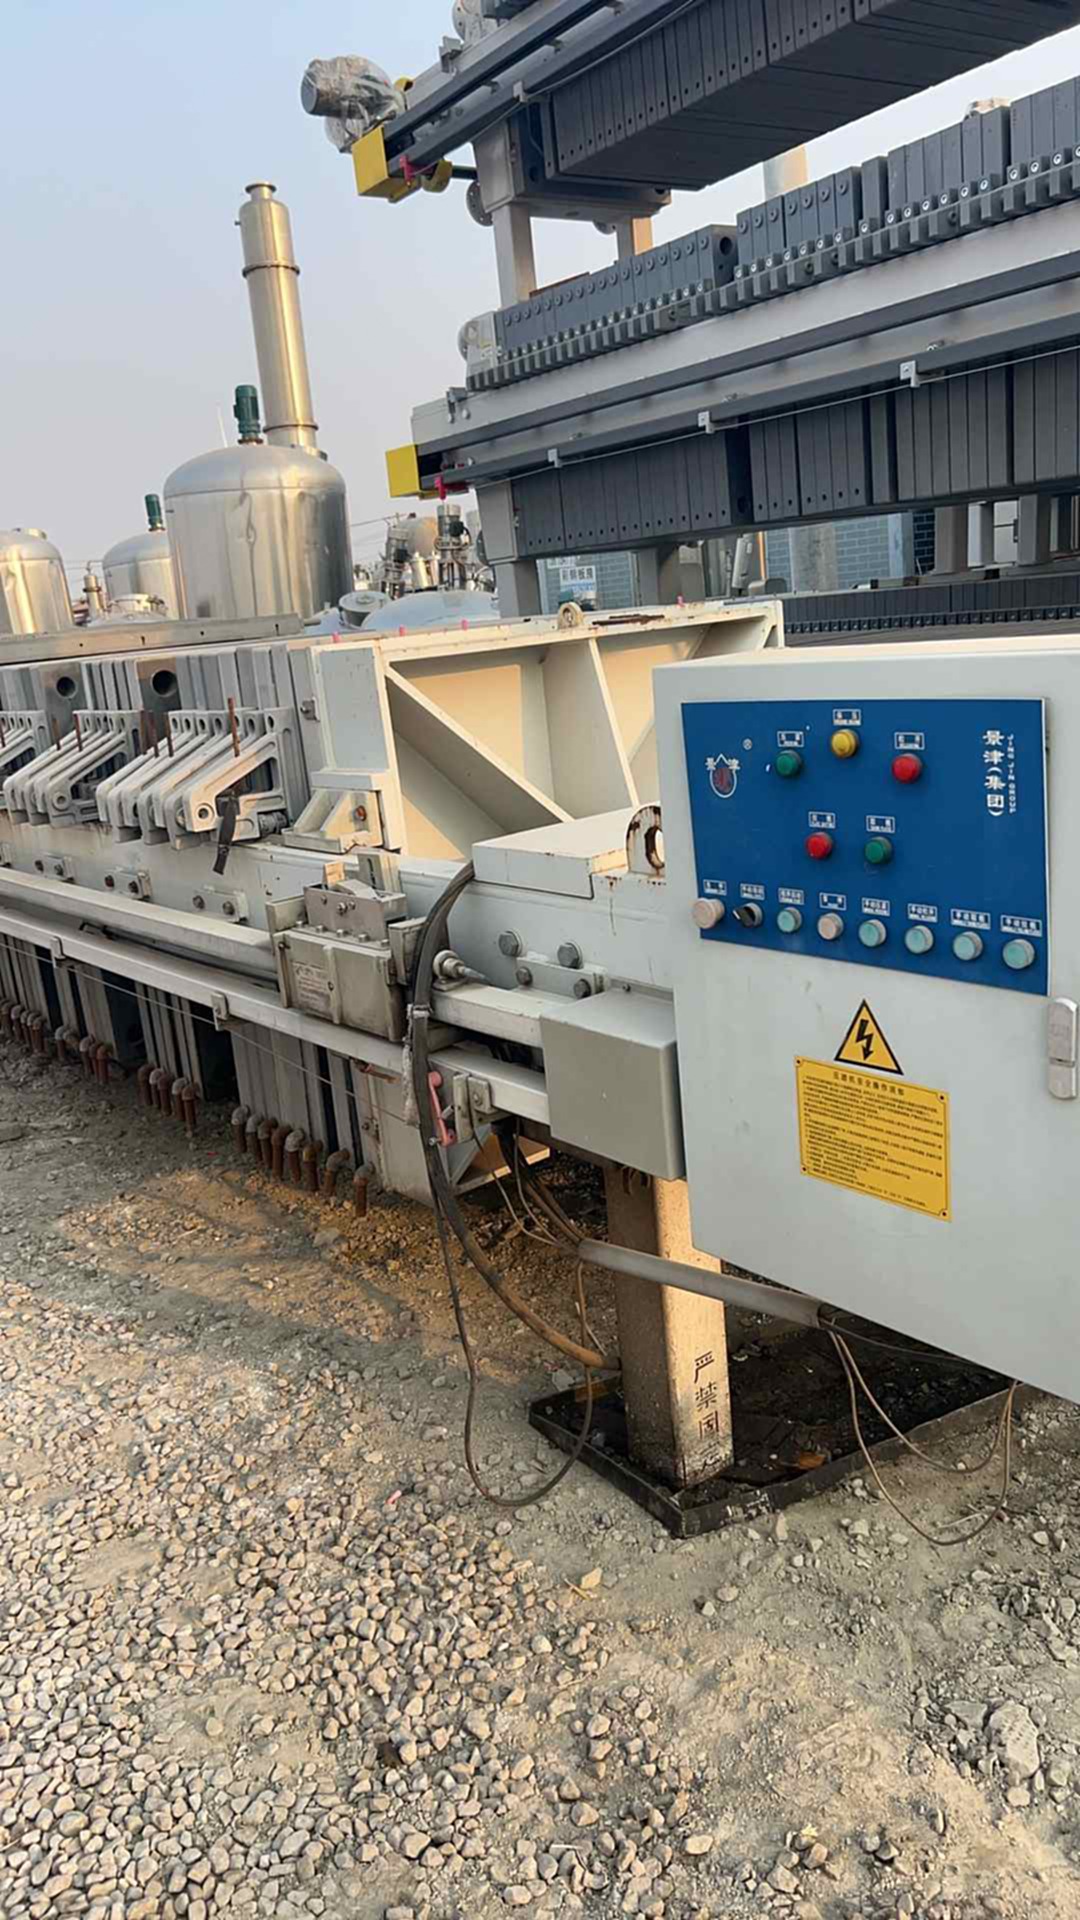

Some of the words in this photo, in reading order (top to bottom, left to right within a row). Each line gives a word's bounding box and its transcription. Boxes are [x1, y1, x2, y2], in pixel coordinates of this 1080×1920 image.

[1007, 733, 1015, 759] JING
[1007, 762, 1015, 780] JIN
[1008, 783, 1017, 814] GROUP
[694, 1351, 722, 1472] 严禁固定
